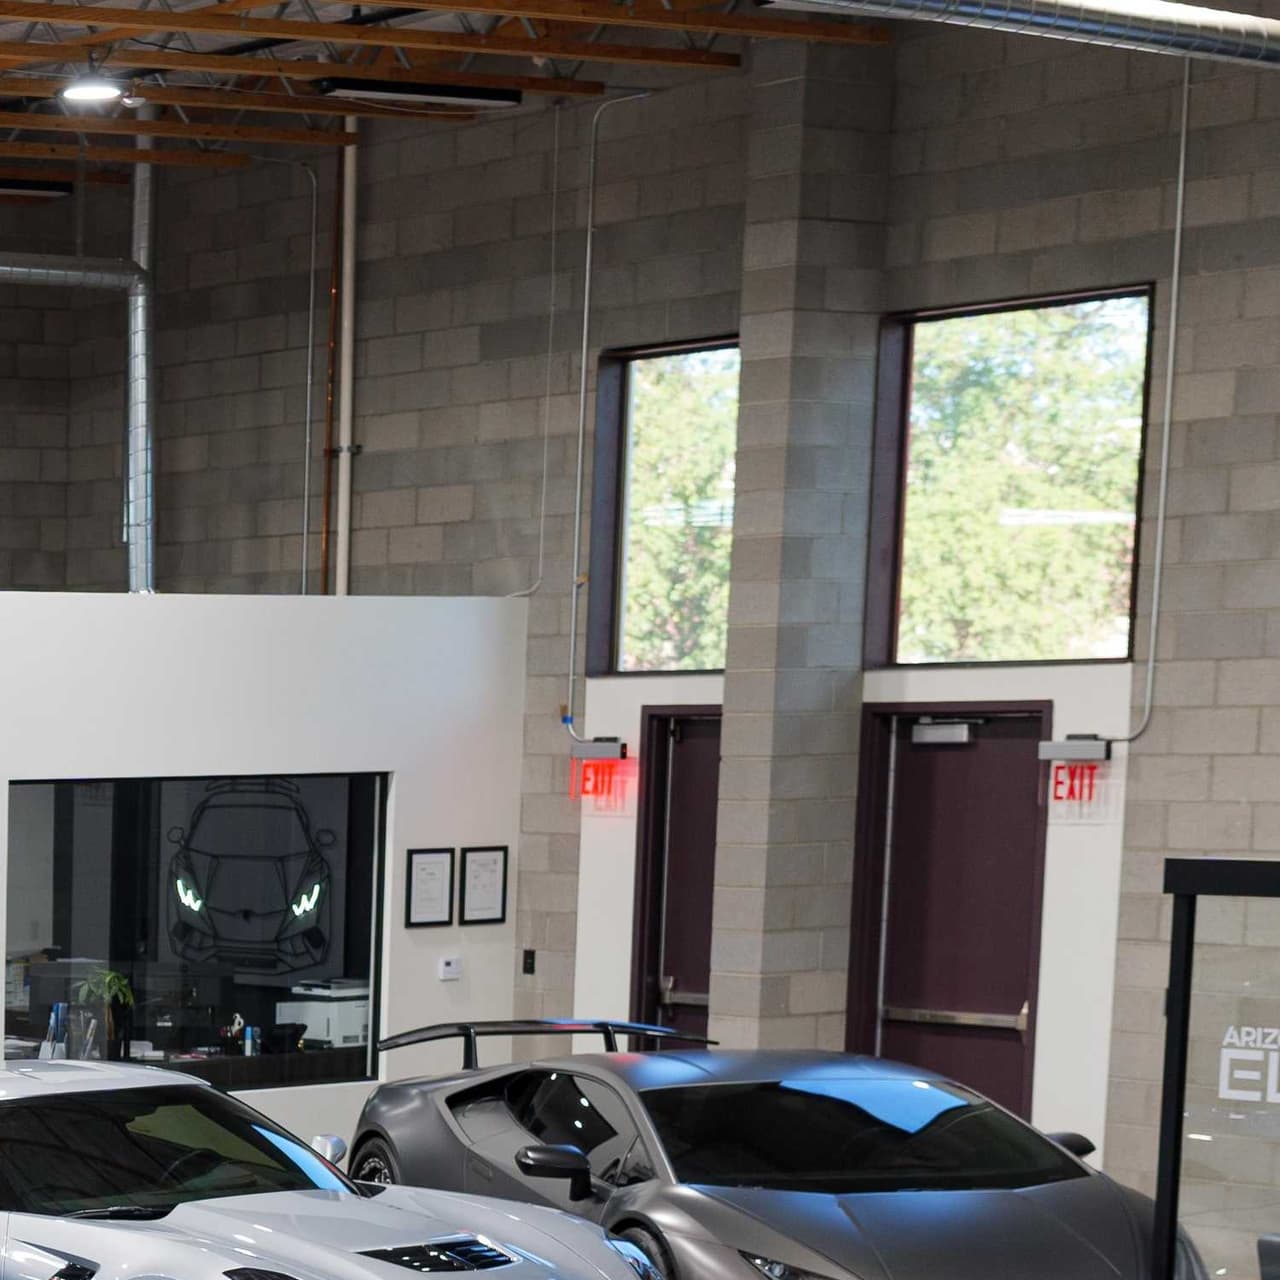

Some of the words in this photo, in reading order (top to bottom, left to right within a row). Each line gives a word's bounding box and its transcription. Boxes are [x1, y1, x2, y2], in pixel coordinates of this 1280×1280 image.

[581, 763, 615, 797] EXIT
[1053, 765, 1097, 801] EXIT
[1222, 1026, 1280, 1049] ARIZ
